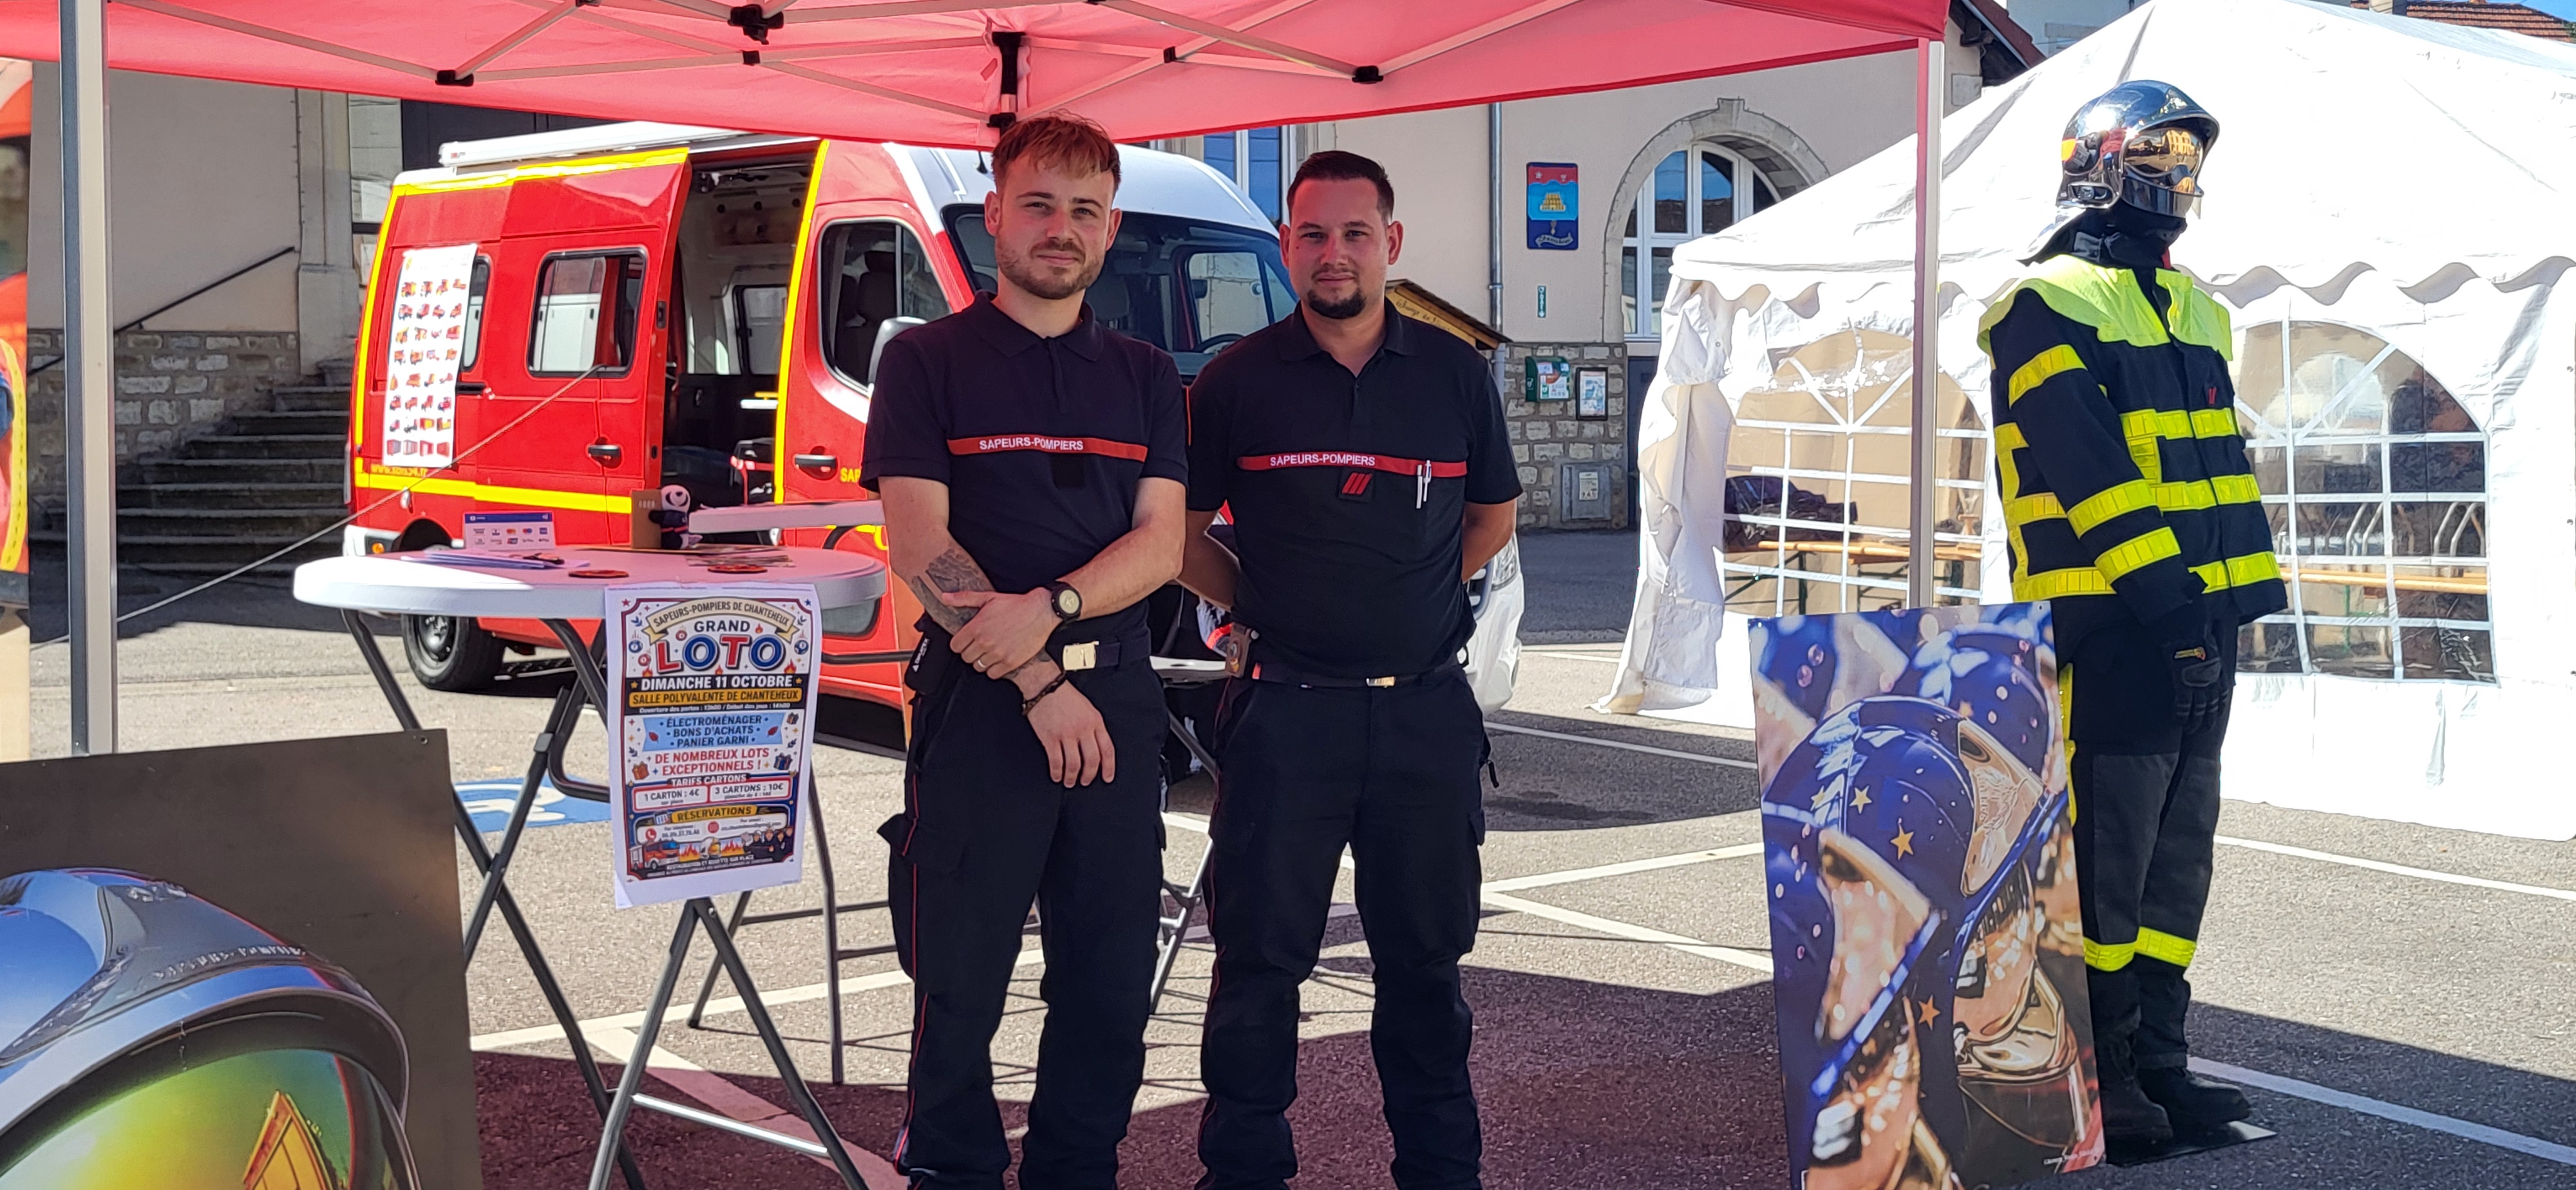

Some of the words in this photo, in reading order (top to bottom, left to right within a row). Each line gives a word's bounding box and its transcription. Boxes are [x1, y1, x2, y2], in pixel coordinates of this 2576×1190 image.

[980, 437, 1084, 450] SAPEURS-POMPIERS
[1270, 454, 1376, 466] SAPEURS-POMPIERS
[653, 601, 731, 627] SAPEURS-POMPIERS
[744, 603, 790, 627] CHANTEHEUX
[694, 620, 750, 632] GRAND
[656, 634, 786, 674] LOTO
[641, 677, 712, 691] DIMANCHE
[715, 676, 726, 688] 11
[731, 675, 793, 688] OCTOBRE
[633, 693, 661, 704] SALLE
[663, 691, 724, 703] POLYVALENTE
[727, 691, 738, 701] DE
[741, 690, 799, 701] CHANTEHEUX
[667, 715, 762, 728] ÉLECTROMÉNAGER
[674, 728, 701, 737] BONS
[705, 726, 753, 735] D'ACHATS
[677, 737, 714, 748] PANIER
[717, 735, 749, 745] GARNI
[656, 753, 669, 764] DE
[673, 750, 738, 762] NOMBREUX
[741, 748, 769, 758] LOTS
[662, 760, 753, 775] EXCEPTIONNELS
[757, 760, 761, 770] !
[671, 777, 702, 786] TARIFS
[704, 774, 747, 784] CARTONS
[650, 790, 682, 800] CARTON
[723, 784, 761, 793] CARTONS
[677, 806, 752, 821] RÉSERVATIONS
